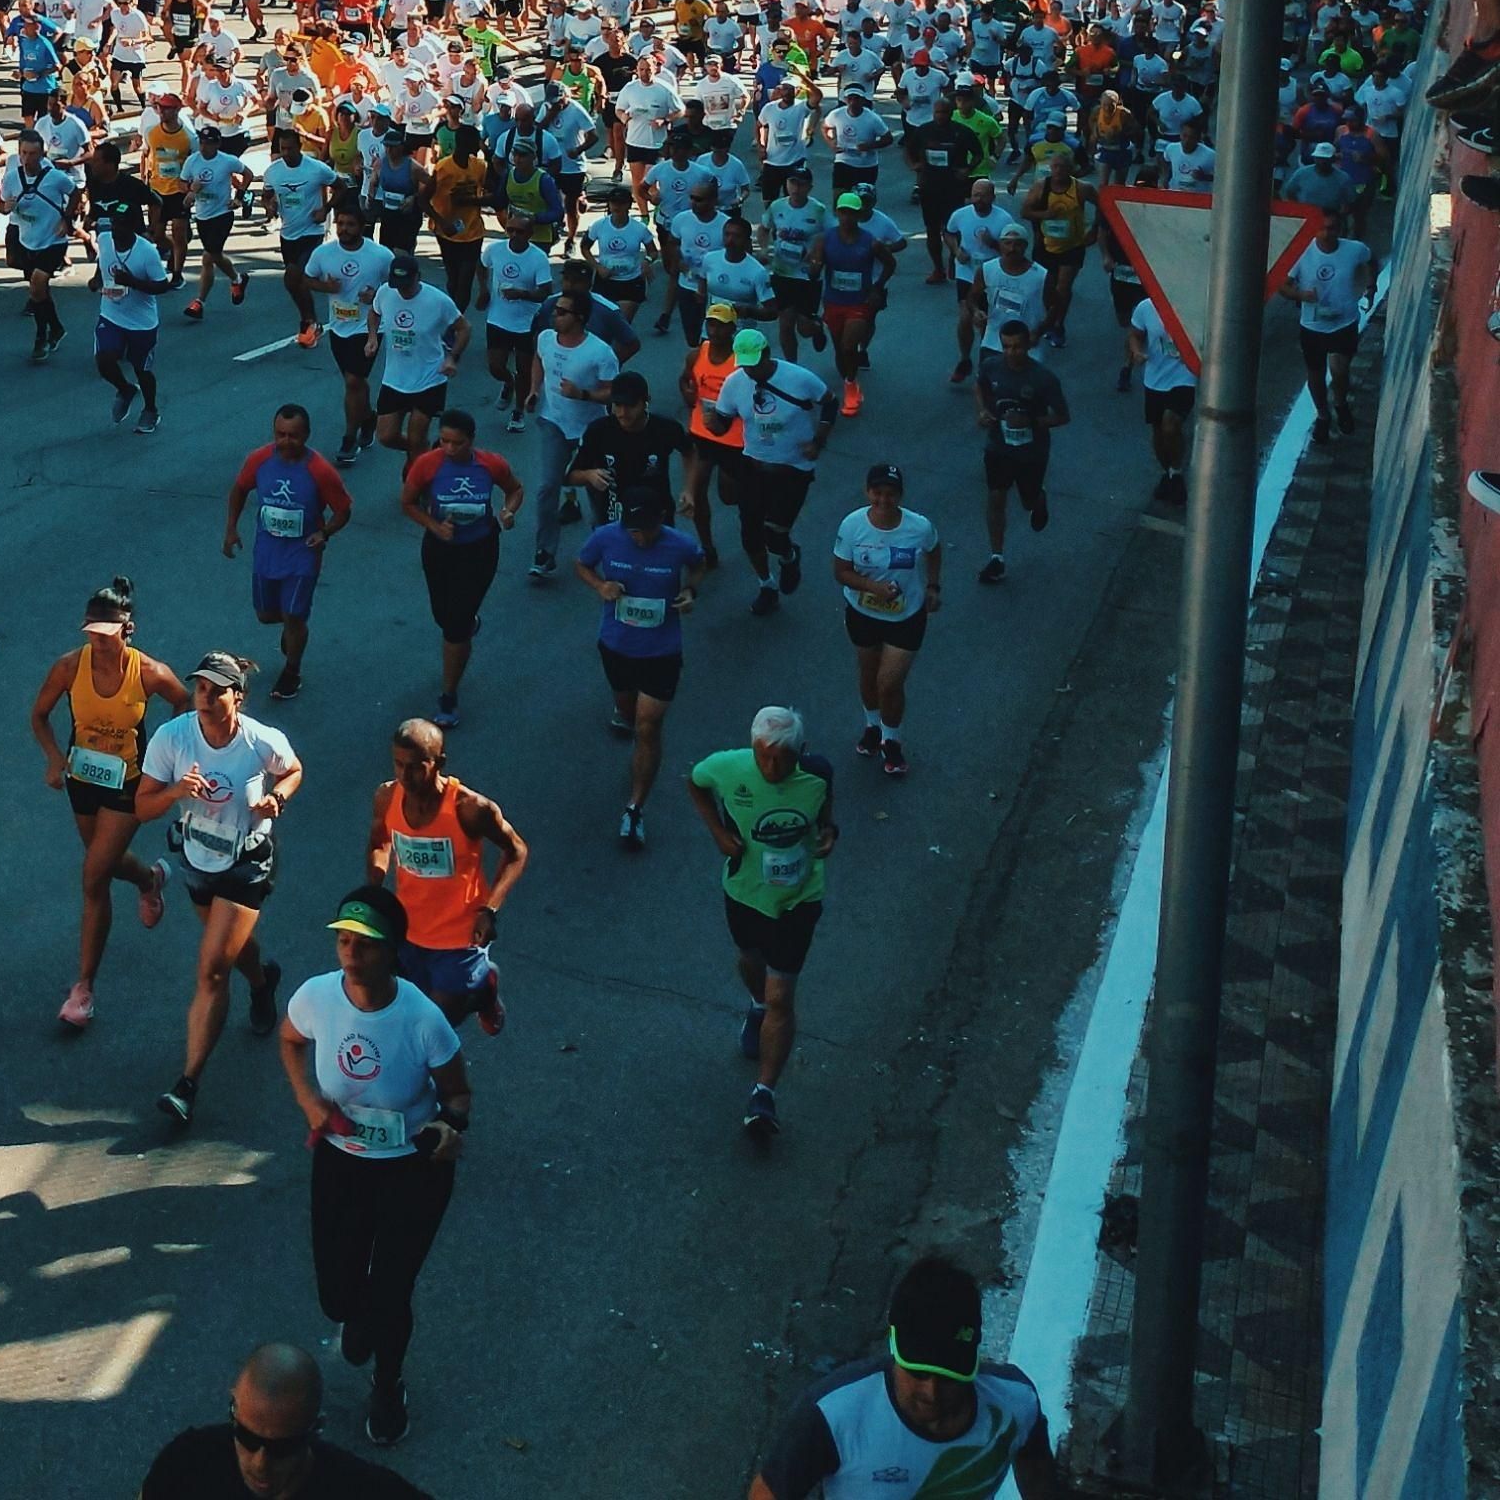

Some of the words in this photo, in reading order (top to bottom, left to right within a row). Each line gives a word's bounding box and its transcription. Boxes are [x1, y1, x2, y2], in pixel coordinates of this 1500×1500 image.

[80, 762, 112, 781] 9828
[404, 850, 438, 865] 2684
[352, 1123, 388, 1143] 273
